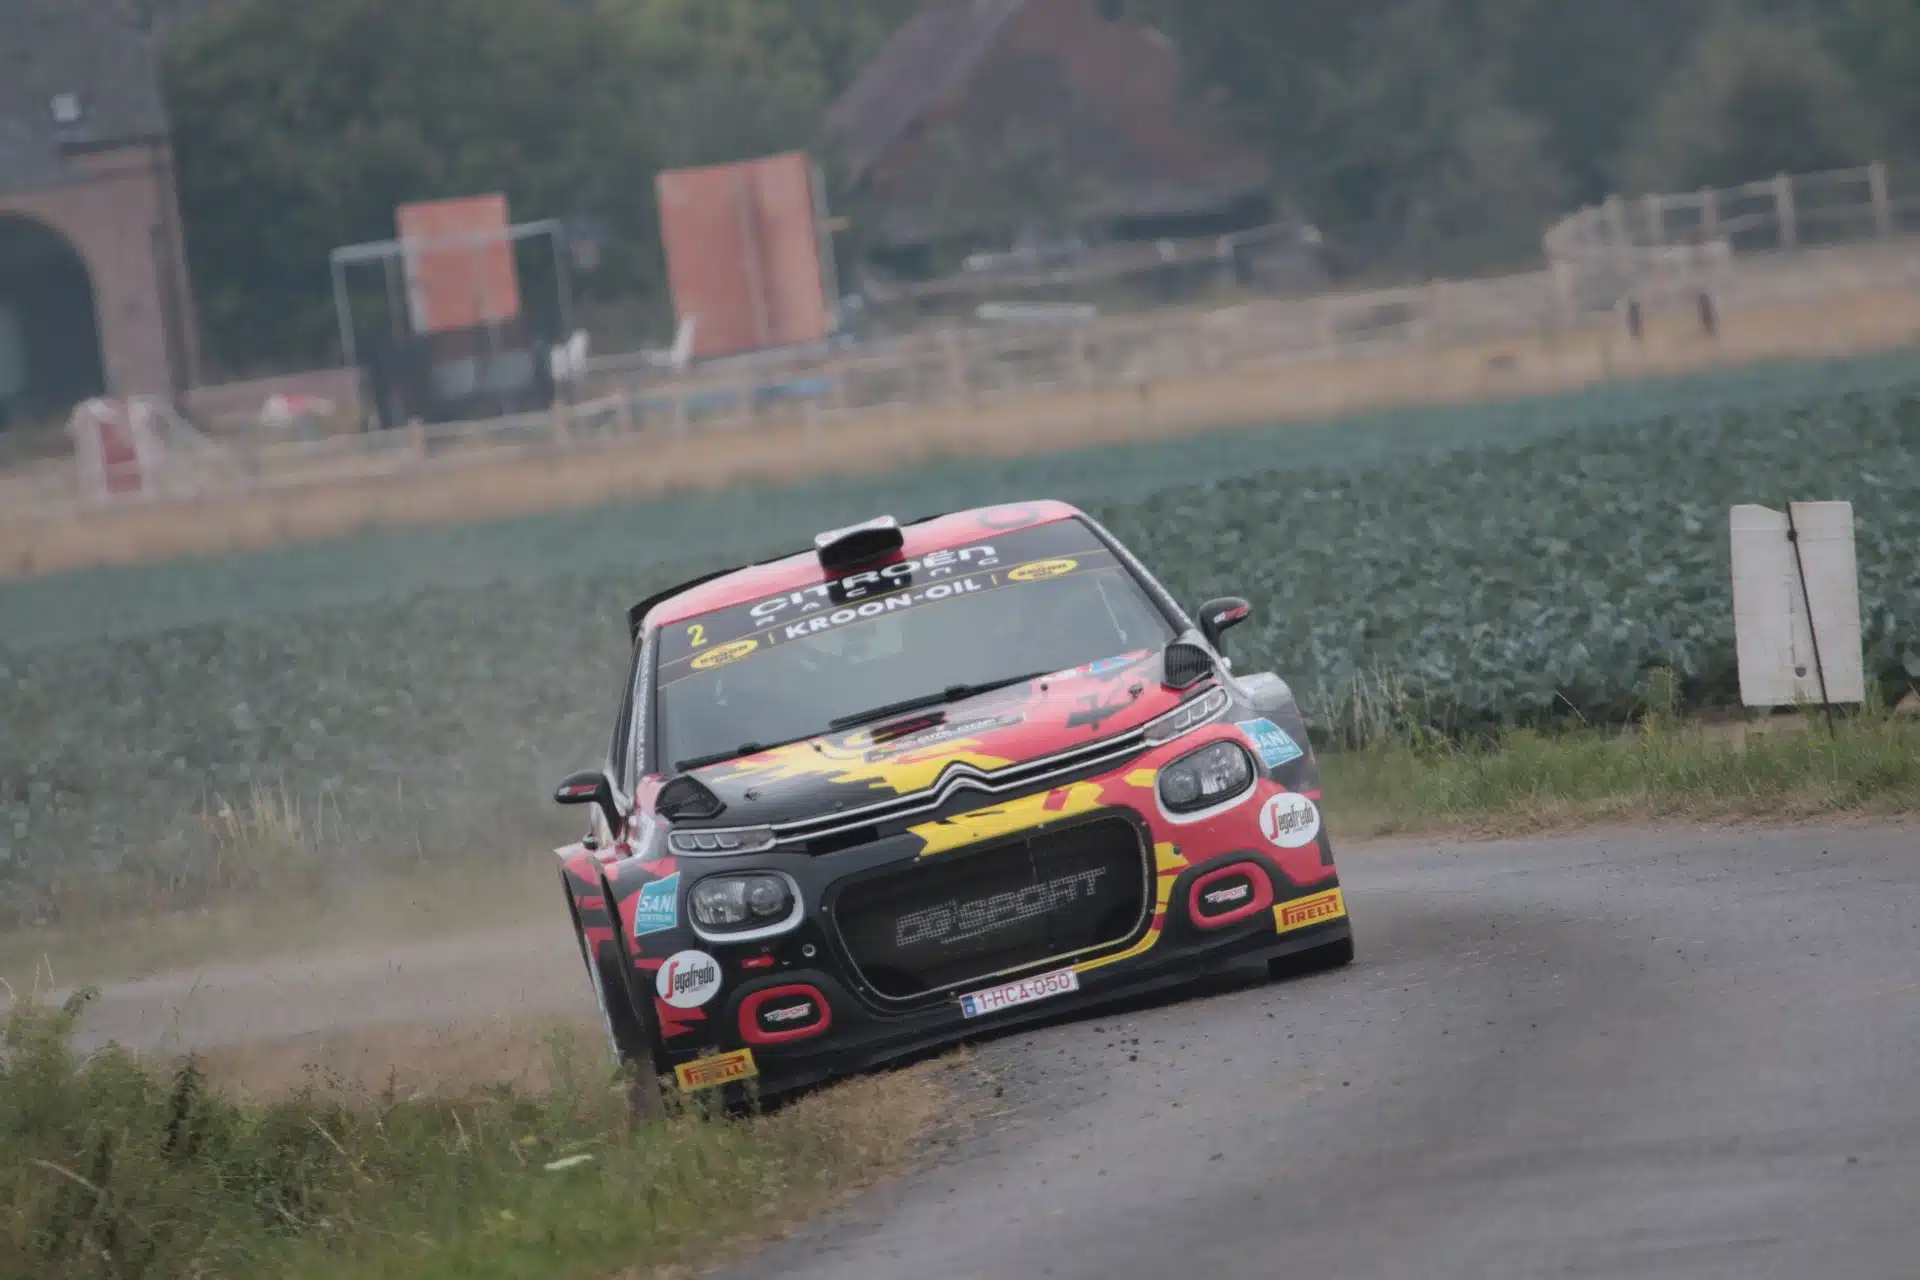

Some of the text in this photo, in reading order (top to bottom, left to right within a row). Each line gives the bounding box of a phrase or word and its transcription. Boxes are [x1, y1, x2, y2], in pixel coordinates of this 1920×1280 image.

[785, 578, 982, 639] KROON-OIL
[687, 624, 707, 647] 2
[639, 895, 675, 913] SANI
[1281, 895, 1338, 926] PIRELLI
[664, 961, 714, 999] Segafredo
[979, 973, 1070, 1010] 1-HCA-050
